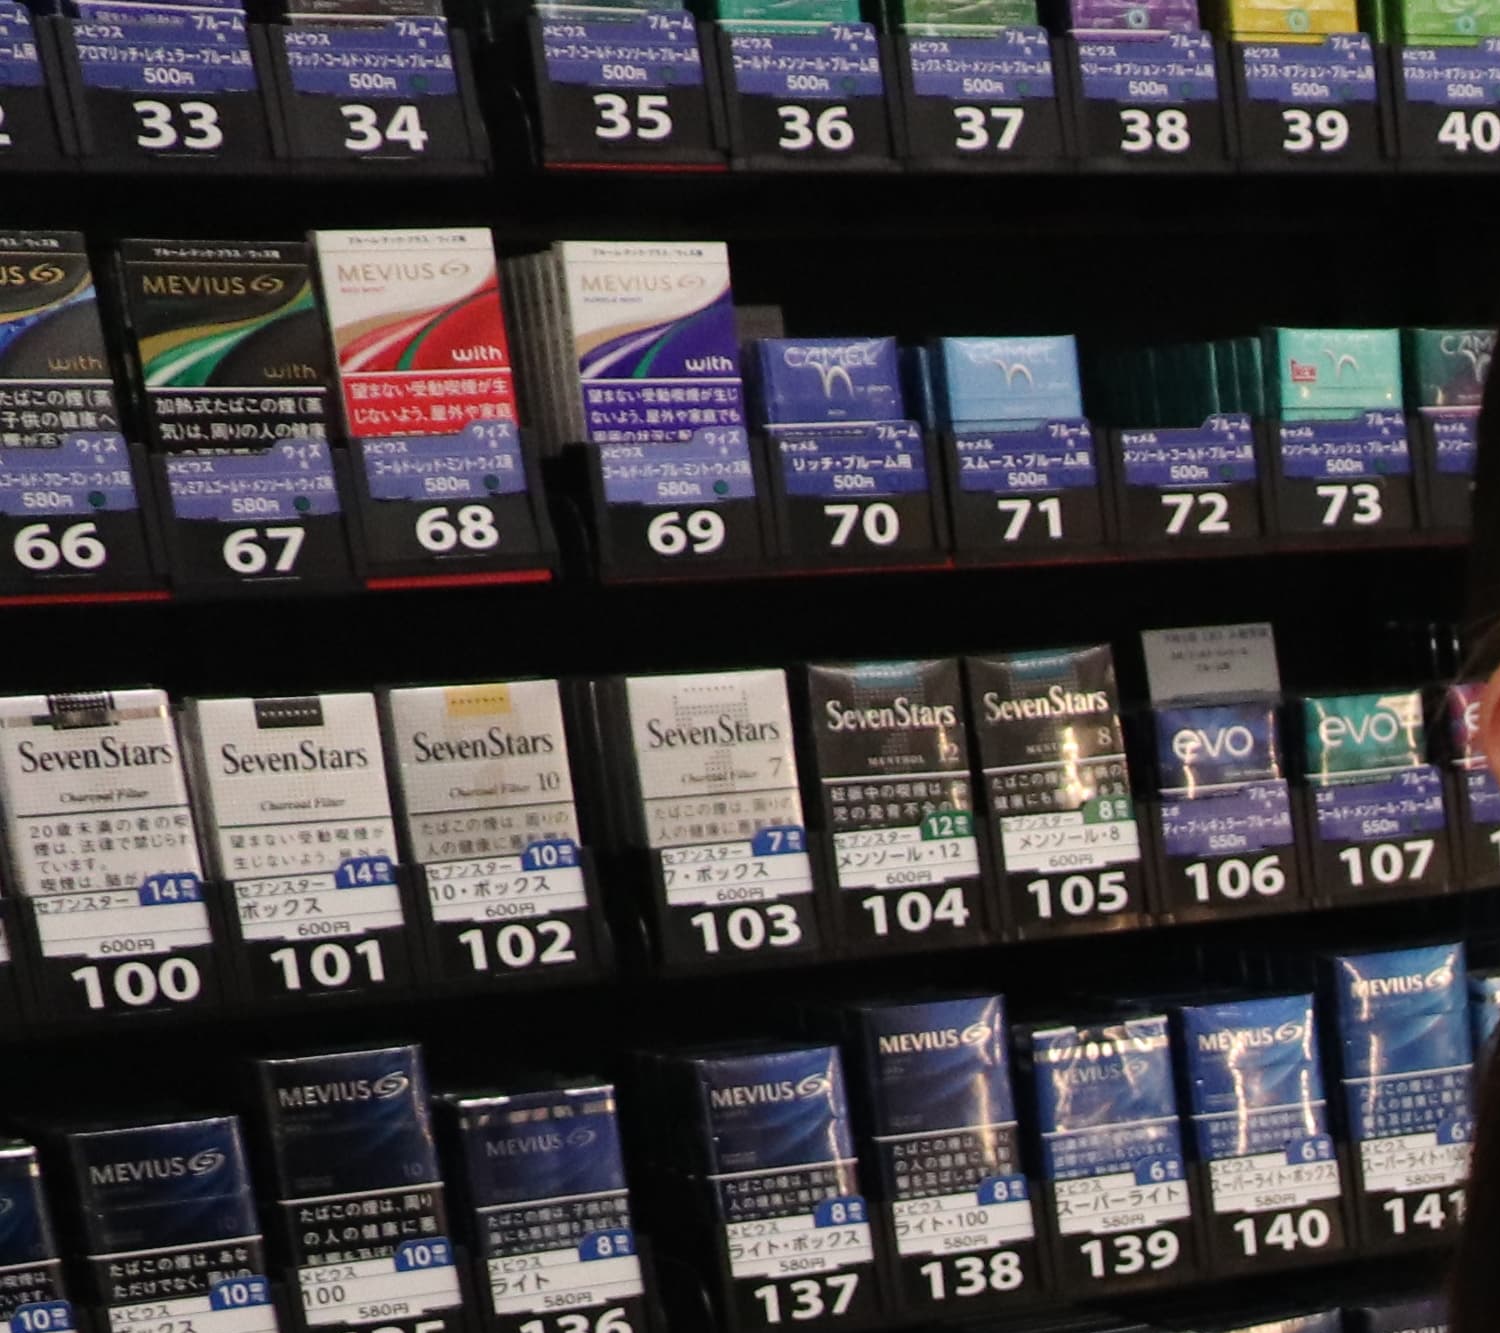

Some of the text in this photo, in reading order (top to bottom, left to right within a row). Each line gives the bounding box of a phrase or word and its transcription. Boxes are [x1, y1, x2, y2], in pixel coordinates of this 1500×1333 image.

[144, 68, 193, 86] 500円
[352, 73, 396, 90] 500円
[134, 101, 222, 148] 33
[341, 105, 427, 150] 34
[594, 94, 671, 138] 35
[779, 106, 853, 149] 36
[954, 107, 1023, 149] 37
[1121, 110, 1189, 151] 38
[1283, 110, 1348, 150] 39
[143, 274, 246, 296] MEVIUS
[338, 261, 434, 283] MEVIUS
[581, 273, 671, 293] MEVIUS
[451, 346, 502, 363] with
[686, 356, 732, 373] with
[424, 475, 470, 493] 580円
[825, 504, 898, 545] 70
[998, 499, 1061, 540] 71
[1162, 493, 1229, 533] 72
[1317, 485, 1381, 524] 73
[15, 523, 105, 569] 66
[416, 506, 498, 550] 68
[648, 511, 724, 554] 69
[224, 527, 304, 572] 67
[826, 700, 956, 732] SevenStars
[984, 686, 1108, 719] SevenStars
[414, 731, 554, 762] SevenStars
[648, 721, 781, 750] SevenStars
[1172, 725, 1253, 761] evo
[1319, 711, 1400, 747] evo
[20, 736, 173, 774] SevenStars
[222, 746, 368, 776] SevenStars
[1186, 856, 1284, 900] 106
[1340, 840, 1433, 885] 107
[242, 899, 322, 918] ボックス
[485, 902, 535, 919] 600円
[863, 888, 969, 934] 104
[1028, 872, 1127, 917] 105
[99, 937, 154, 953] 600円
[298, 920, 350, 936] 600円
[459, 921, 575, 969] 102
[695, 905, 801, 952] 103
[72, 958, 199, 1008] 100
[271, 940, 383, 989] 101
[880, 1029, 959, 1054] MEVIUS
[279, 1081, 373, 1108] MEVIUS
[712, 1078, 796, 1108] MEVIUS
[91, 1156, 188, 1185] MEVIUS
[1235, 1210, 1329, 1254] 140
[1081, 1231, 1178, 1276] 139
[921, 1252, 1022, 1298] 138
[755, 1274, 858, 1322] 137
